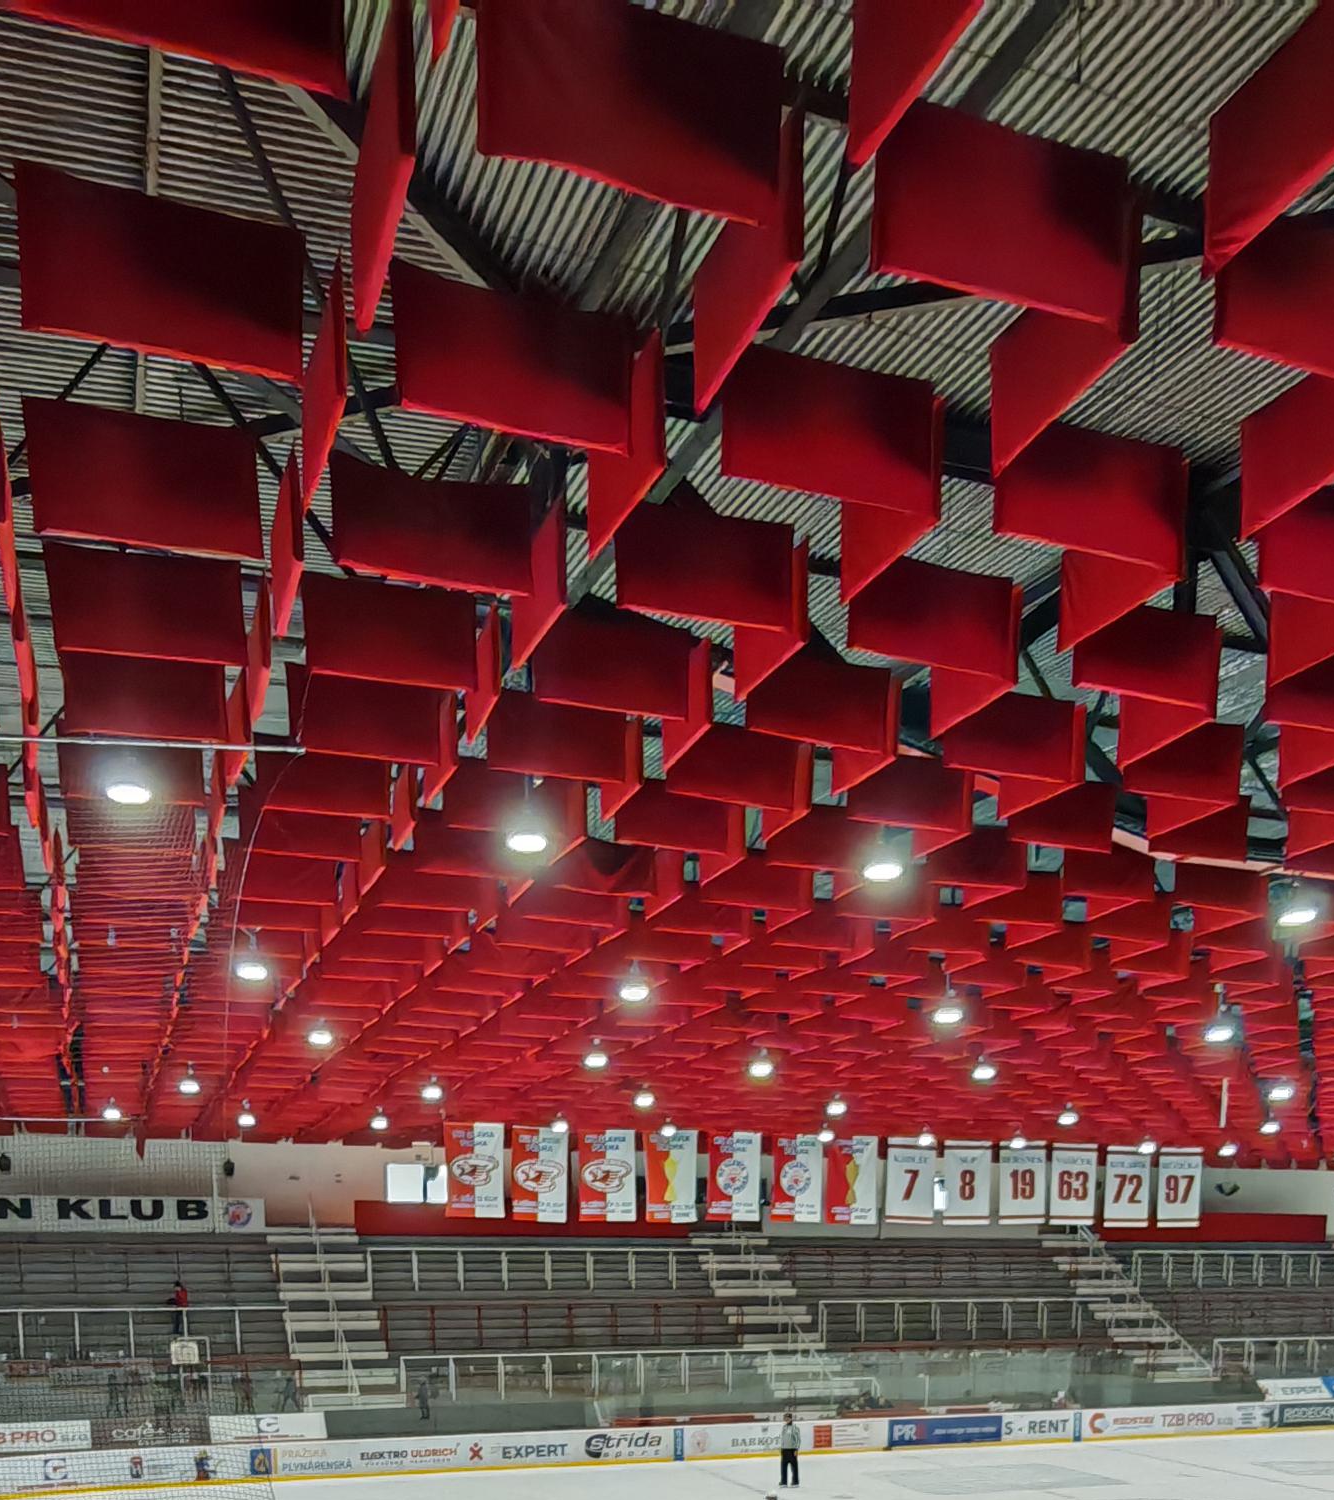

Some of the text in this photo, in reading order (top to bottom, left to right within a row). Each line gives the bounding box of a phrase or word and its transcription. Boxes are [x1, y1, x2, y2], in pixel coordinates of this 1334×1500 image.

[903, 1169, 920, 1201] 7
[959, 1169, 976, 1201] 8
[1010, 1168, 1036, 1200] 19
[1058, 1170, 1089, 1201] 63
[1112, 1174, 1143, 1204] 72
[1165, 1174, 1195, 1204] 97
[57, 1198, 209, 1221] KLUB
[1028, 1418, 1069, 1435] RENT
[1161, 1413, 1185, 1427] TZB
[1187, 1412, 1215, 1426] PRO
[10, 1429, 57, 1445] PRO
[502, 1443, 569, 1459] EXPERT
[603, 1449, 660, 1458] sport
